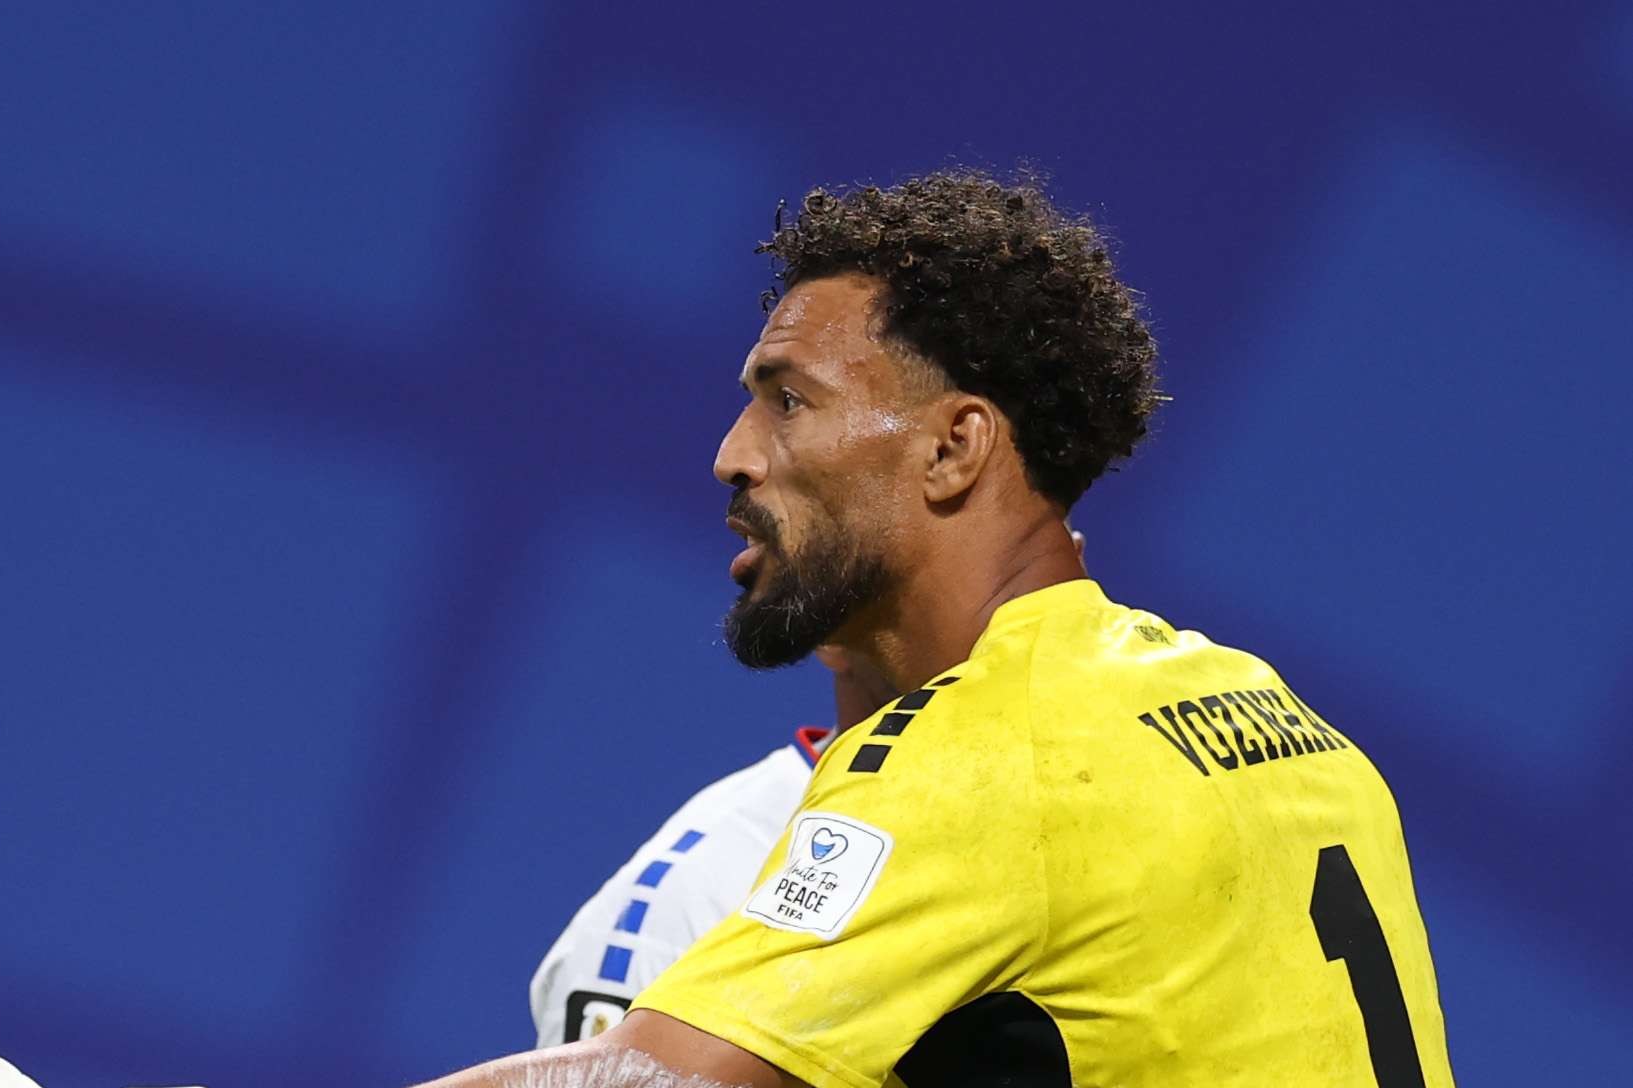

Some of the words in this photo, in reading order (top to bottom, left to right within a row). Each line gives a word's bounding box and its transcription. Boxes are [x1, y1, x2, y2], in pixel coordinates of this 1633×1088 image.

[817, 871, 840, 893] For
[774, 877, 829, 914] PEACE
[776, 903, 803, 921] FIFA
